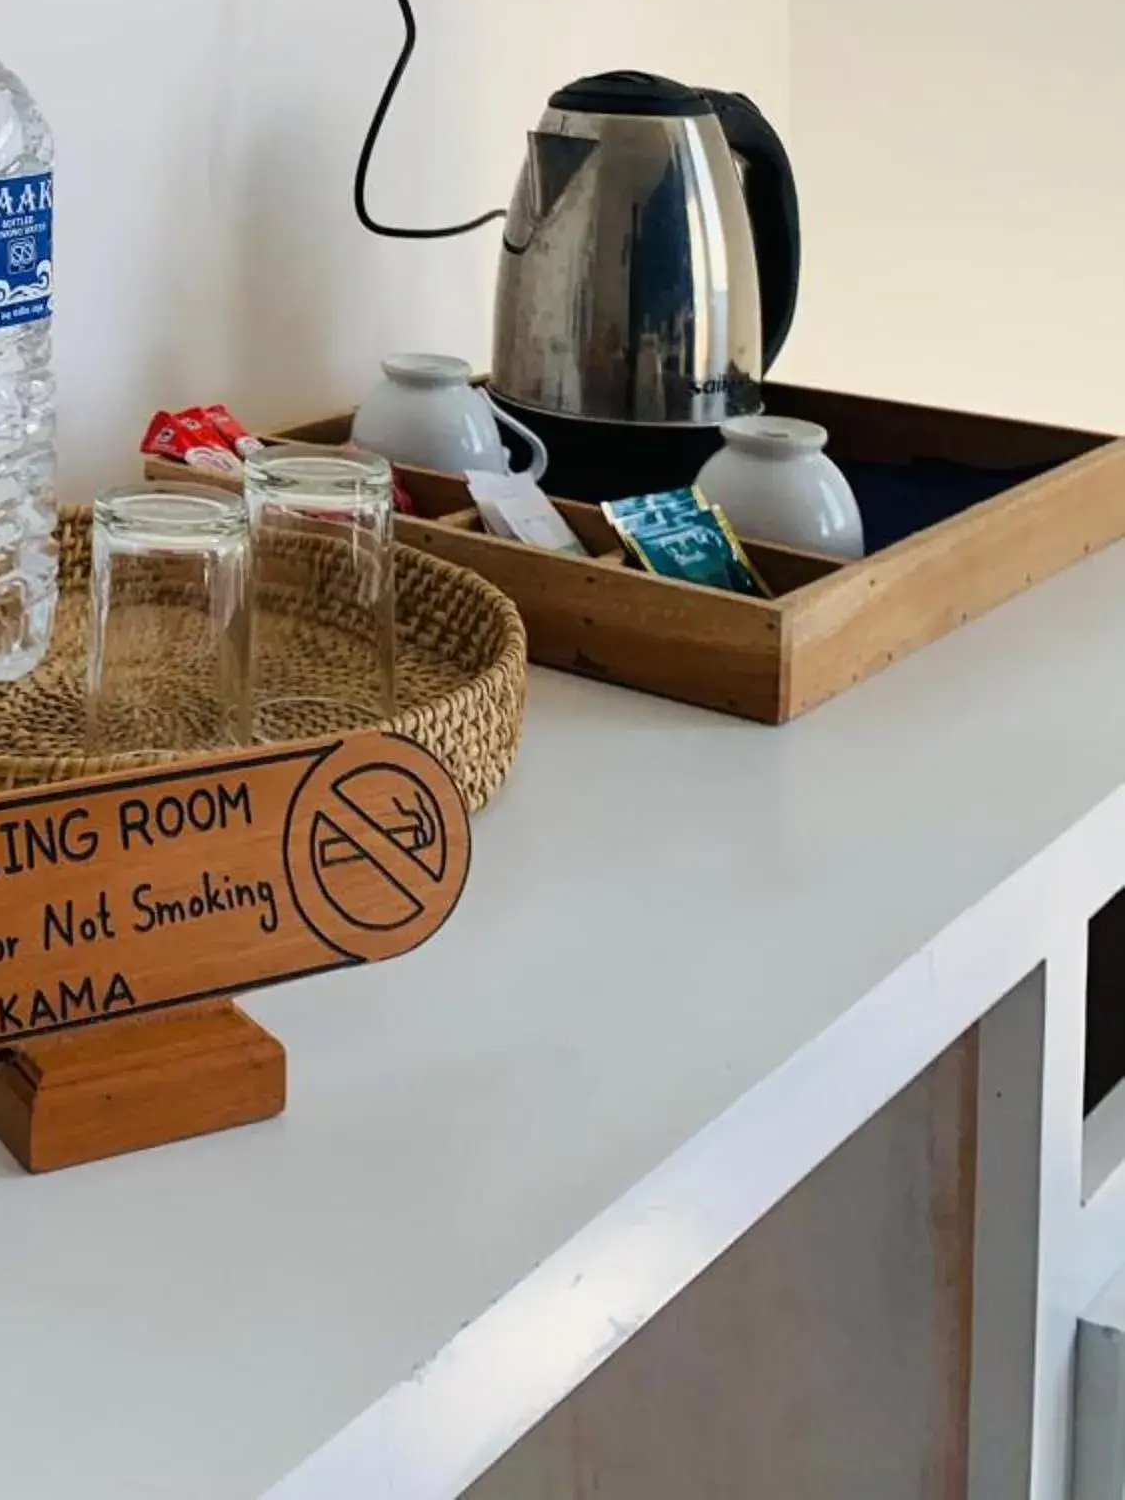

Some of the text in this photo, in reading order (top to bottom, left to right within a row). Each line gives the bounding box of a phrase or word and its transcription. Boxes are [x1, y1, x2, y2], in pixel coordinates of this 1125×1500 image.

[119, 782, 252, 850] ROOM
[43, 891, 115, 951] Not
[132, 871, 278, 933] Smoking
